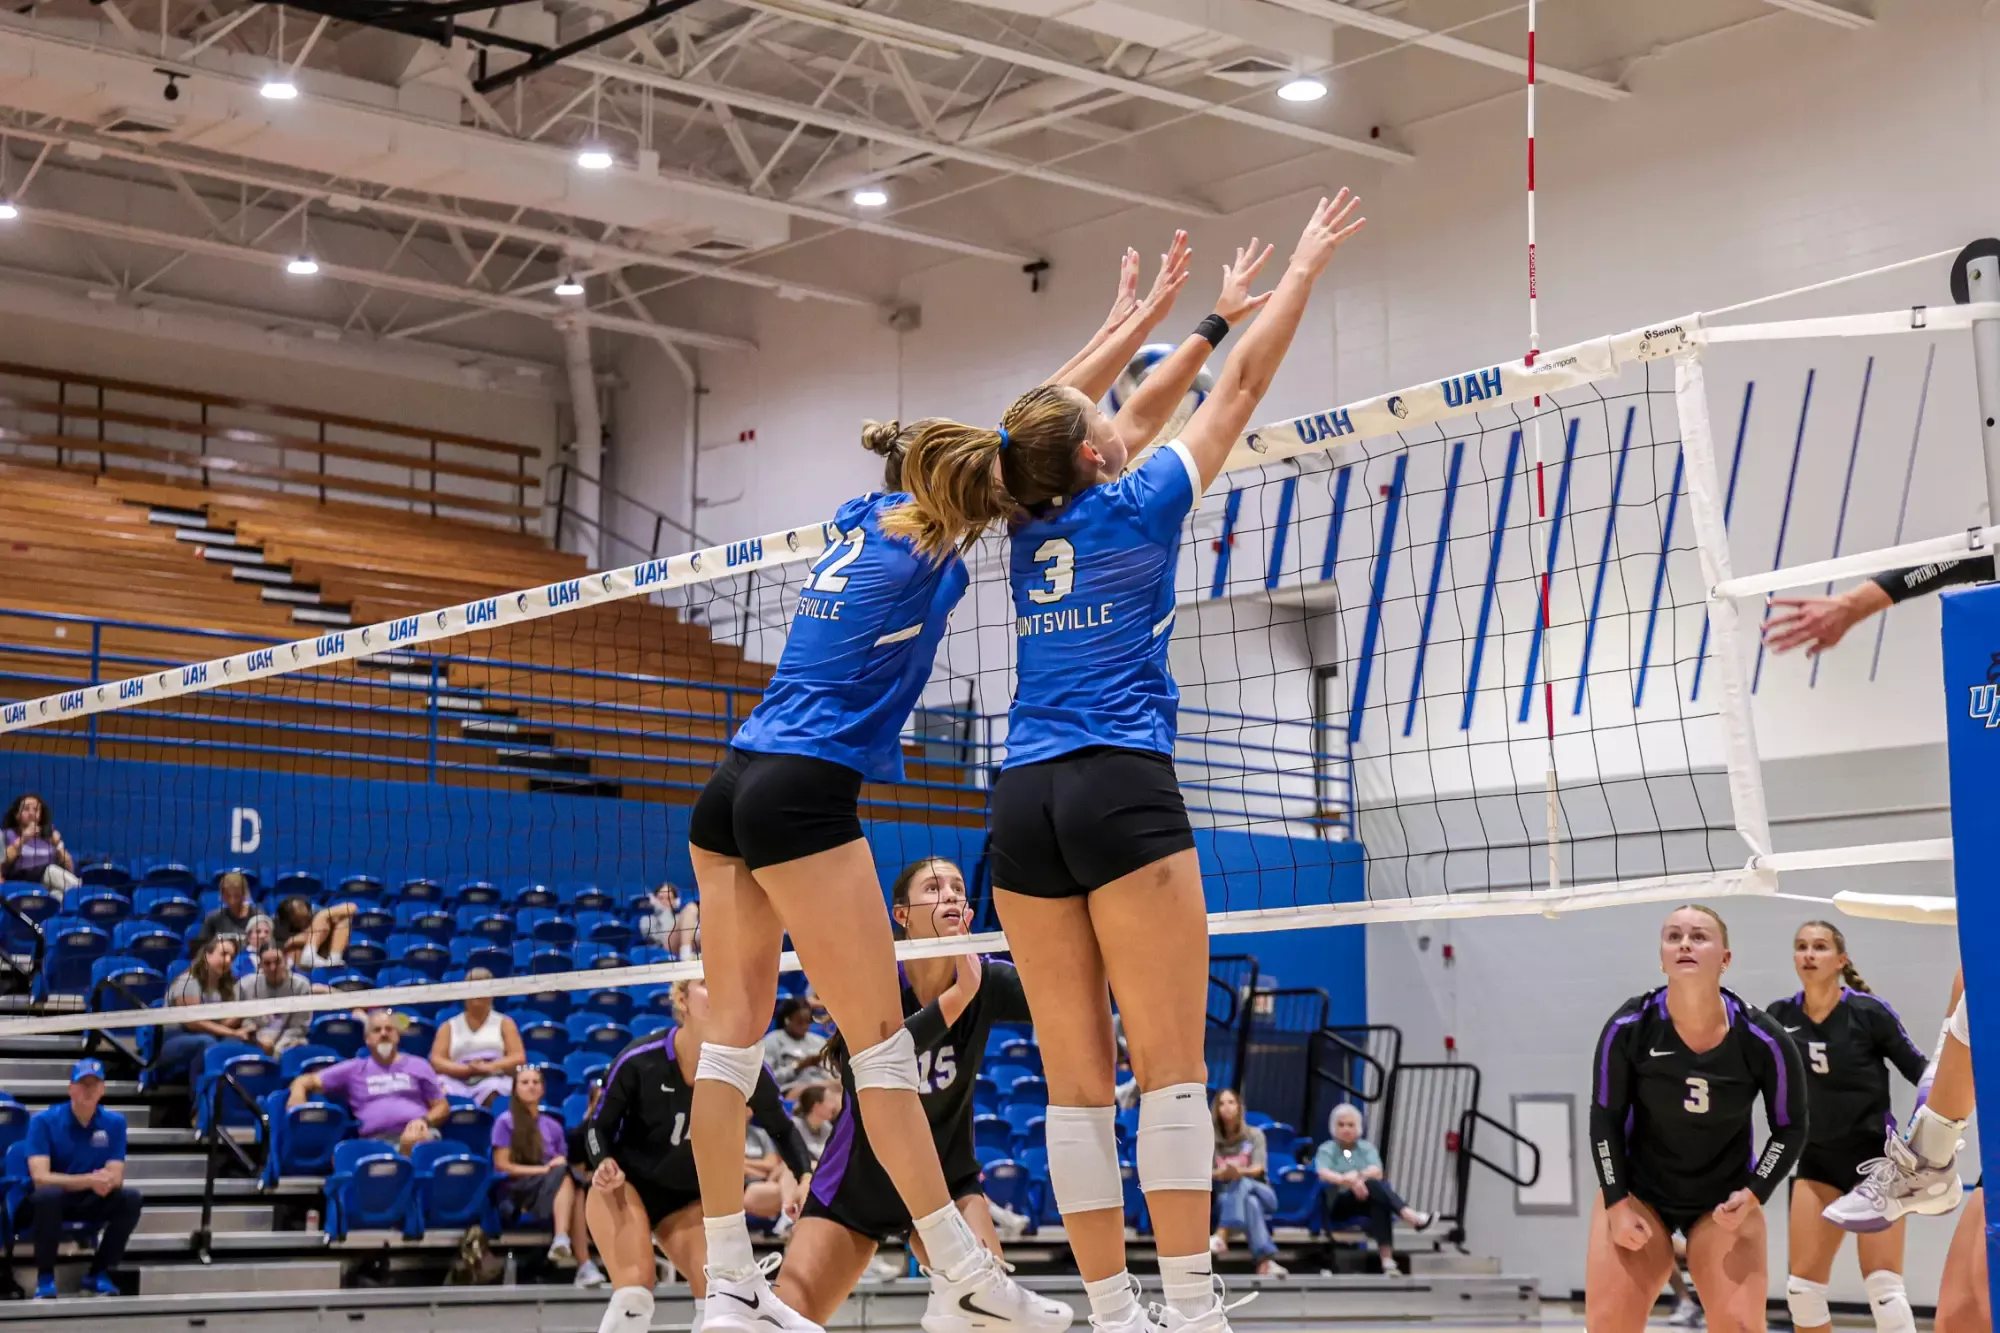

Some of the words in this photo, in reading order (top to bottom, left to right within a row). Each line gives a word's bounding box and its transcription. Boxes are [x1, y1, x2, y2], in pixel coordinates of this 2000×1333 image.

[1652, 324, 1683, 339] Senoh
[1552, 356, 1577, 368] imports
[1442, 366, 1503, 408] UAH
[1294, 407, 1355, 444] UAH
[726, 538, 764, 567] UAH
[634, 558, 669, 586] UAH
[1028, 537, 1075, 605] 3
[547, 580, 580, 607] UAH
[465, 599, 497, 625] UAH
[388, 616, 419, 642] UAH
[315, 633, 345, 657] UAH
[247, 648, 273, 672] UAH
[119, 678, 144, 699] UAH
[182, 664, 207, 687] UAH
[4, 703, 27, 724] UAH
[59, 690, 84, 712] UAH
[231, 807, 261, 854] D
[918, 1045, 957, 1094] 15
[1808, 1042, 1830, 1075] 5
[1684, 1077, 1710, 1114] 3
[1756, 1141, 1785, 1179] BADGERS
